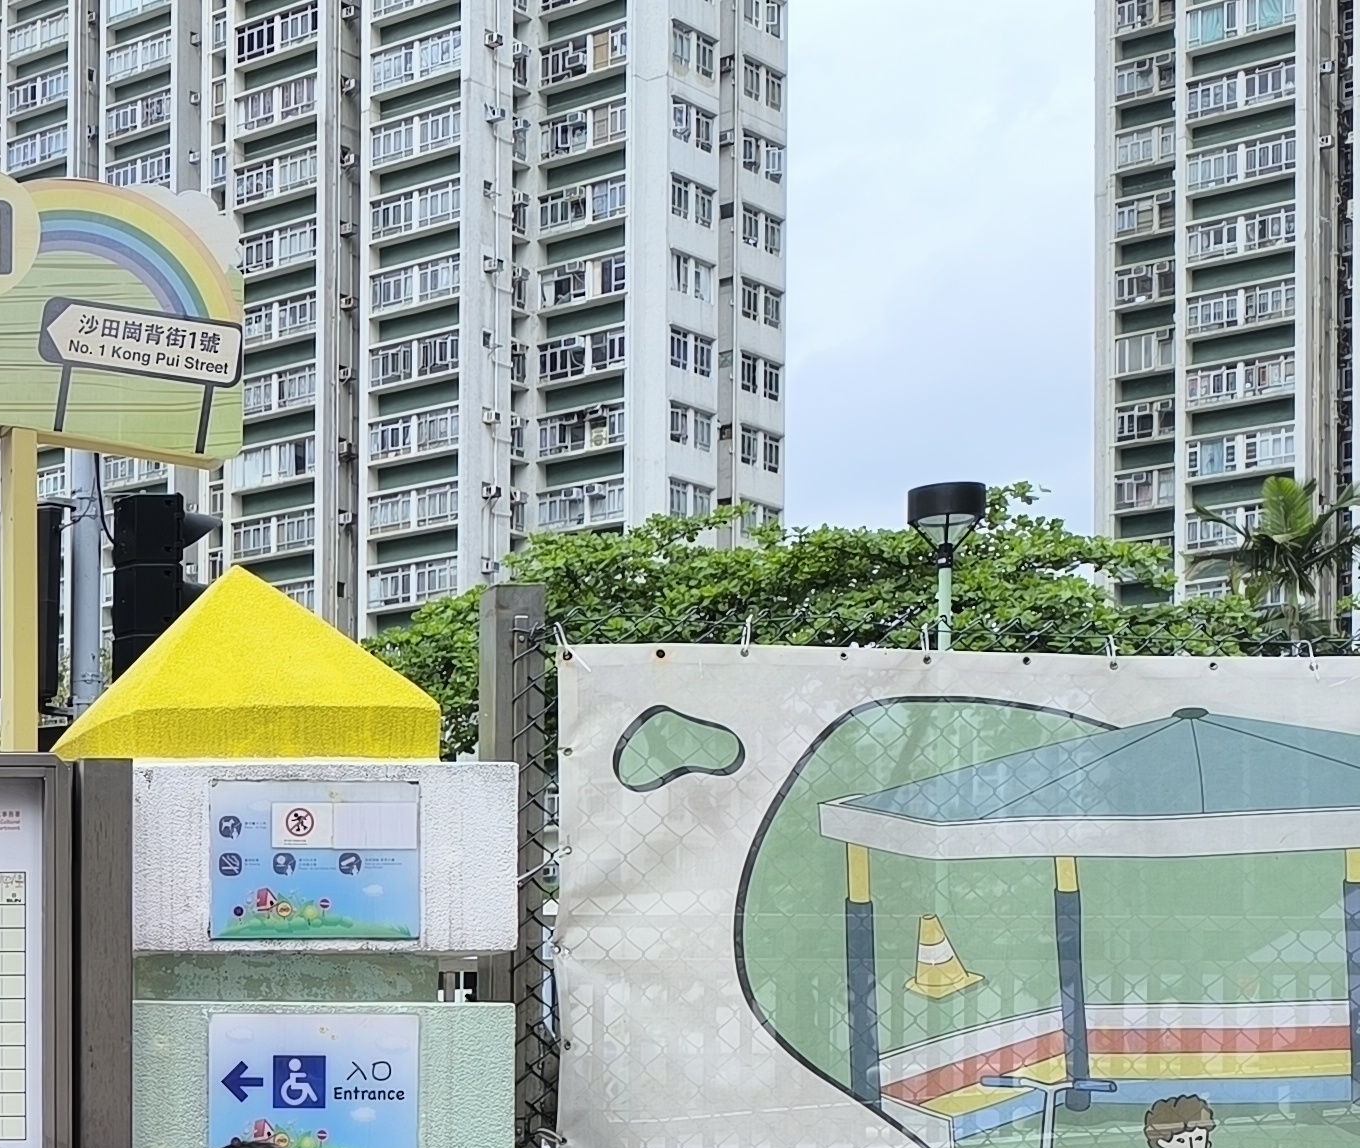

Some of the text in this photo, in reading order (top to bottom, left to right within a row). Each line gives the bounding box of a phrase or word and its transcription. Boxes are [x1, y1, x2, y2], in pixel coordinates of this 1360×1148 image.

[77, 313, 222, 354] 沙田崗背街1號
[68, 338, 229, 375] No. 1 Kong Pui Street
[346, 1061, 392, 1082] 入口
[333, 1086, 406, 1101] Entrance
